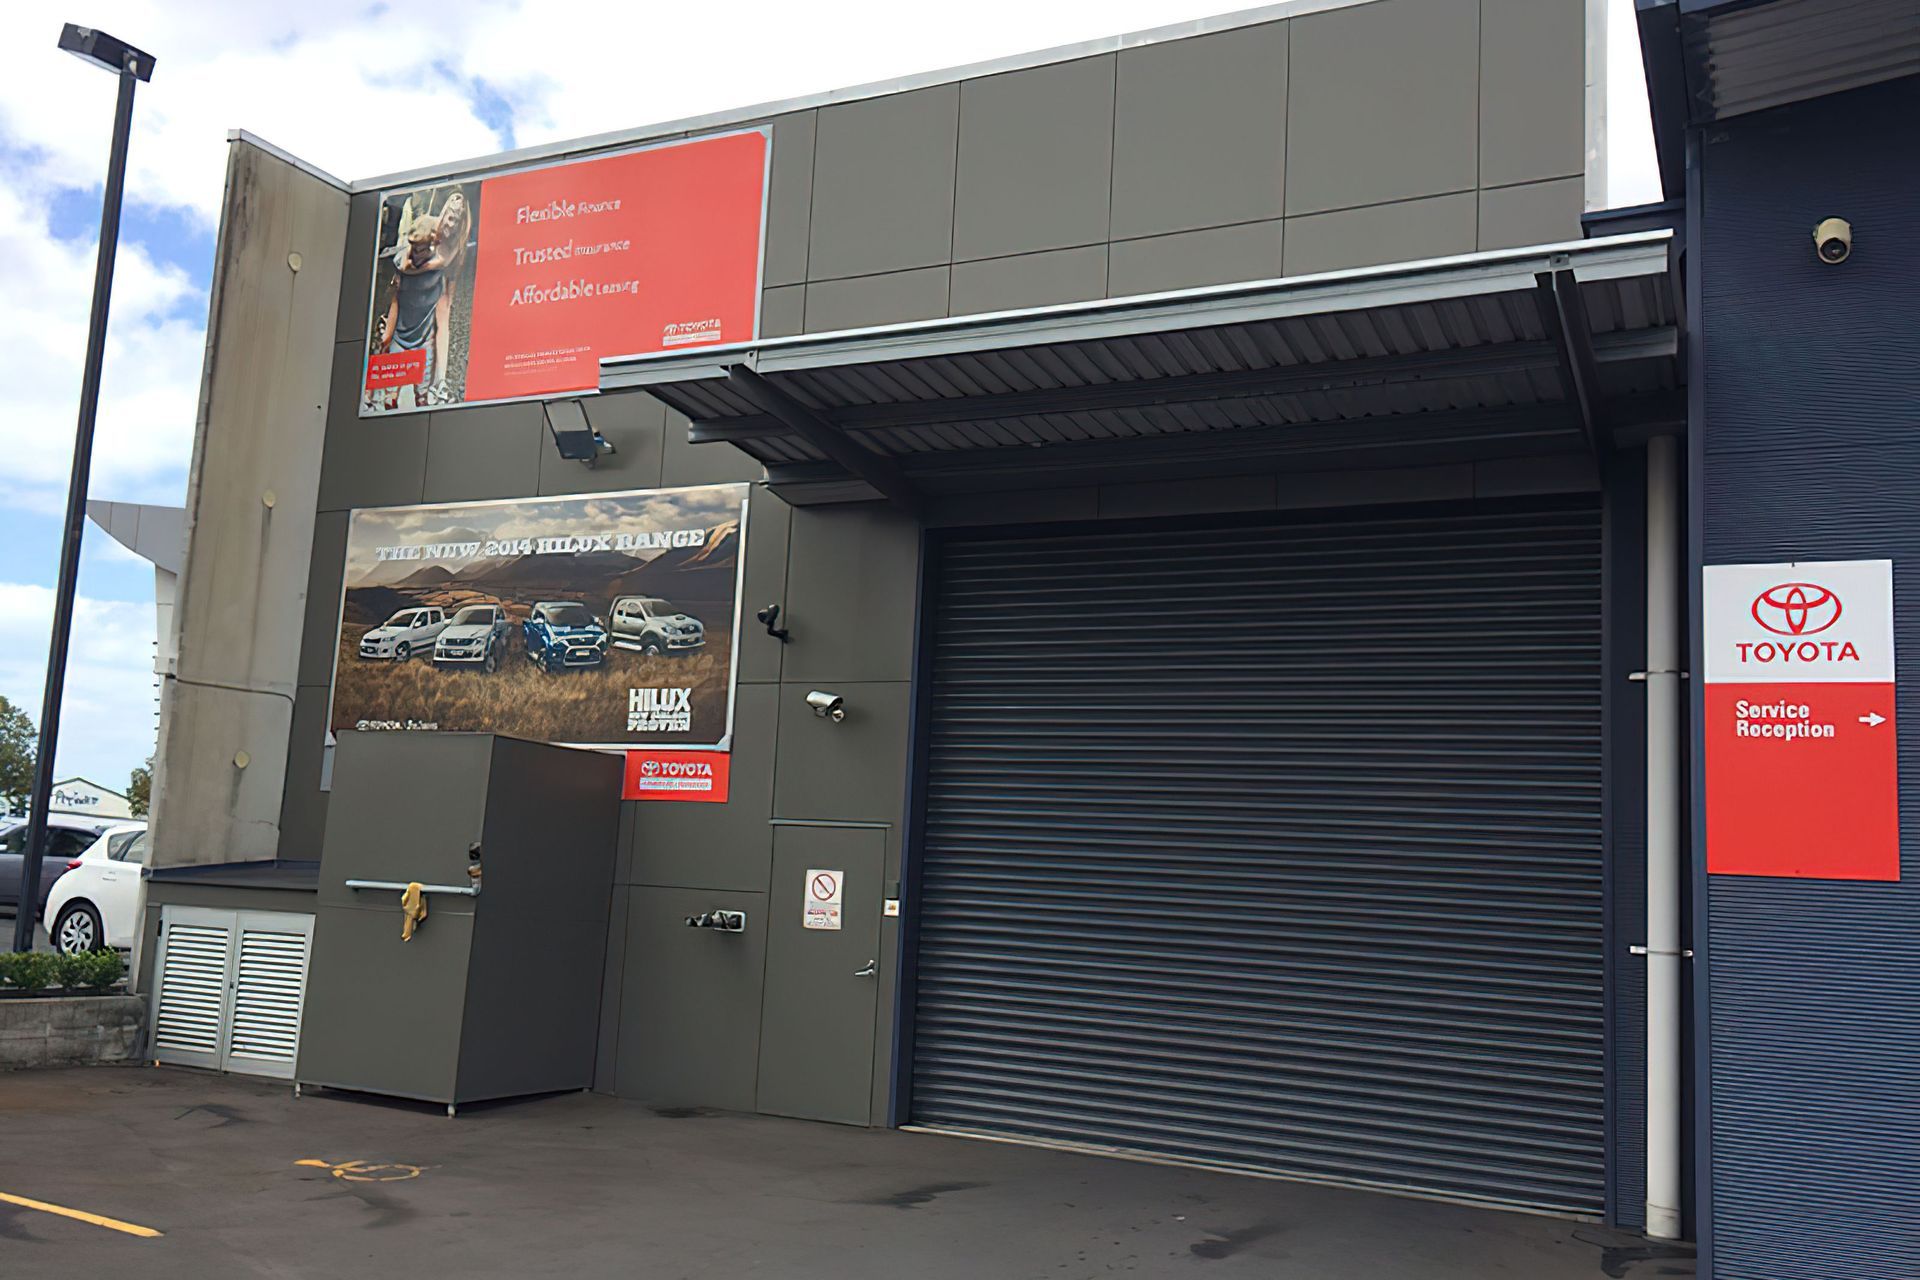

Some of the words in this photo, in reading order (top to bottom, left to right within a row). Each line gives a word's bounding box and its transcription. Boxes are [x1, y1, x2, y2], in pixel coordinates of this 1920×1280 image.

[516, 199, 576, 225] Flexible
[513, 238, 573, 266] Trusted
[509, 278, 594, 307] Affordable
[485, 537, 532, 556] 2014
[535, 534, 612, 555] HILUX
[614, 528, 705, 551] RANGE
[1735, 641, 1860, 663] TOYOTA
[628, 687, 692, 712] HILUX
[1735, 699, 1810, 719] Service
[1736, 719, 1836, 742] Reception
[661, 762, 713, 777] TOYOTA
